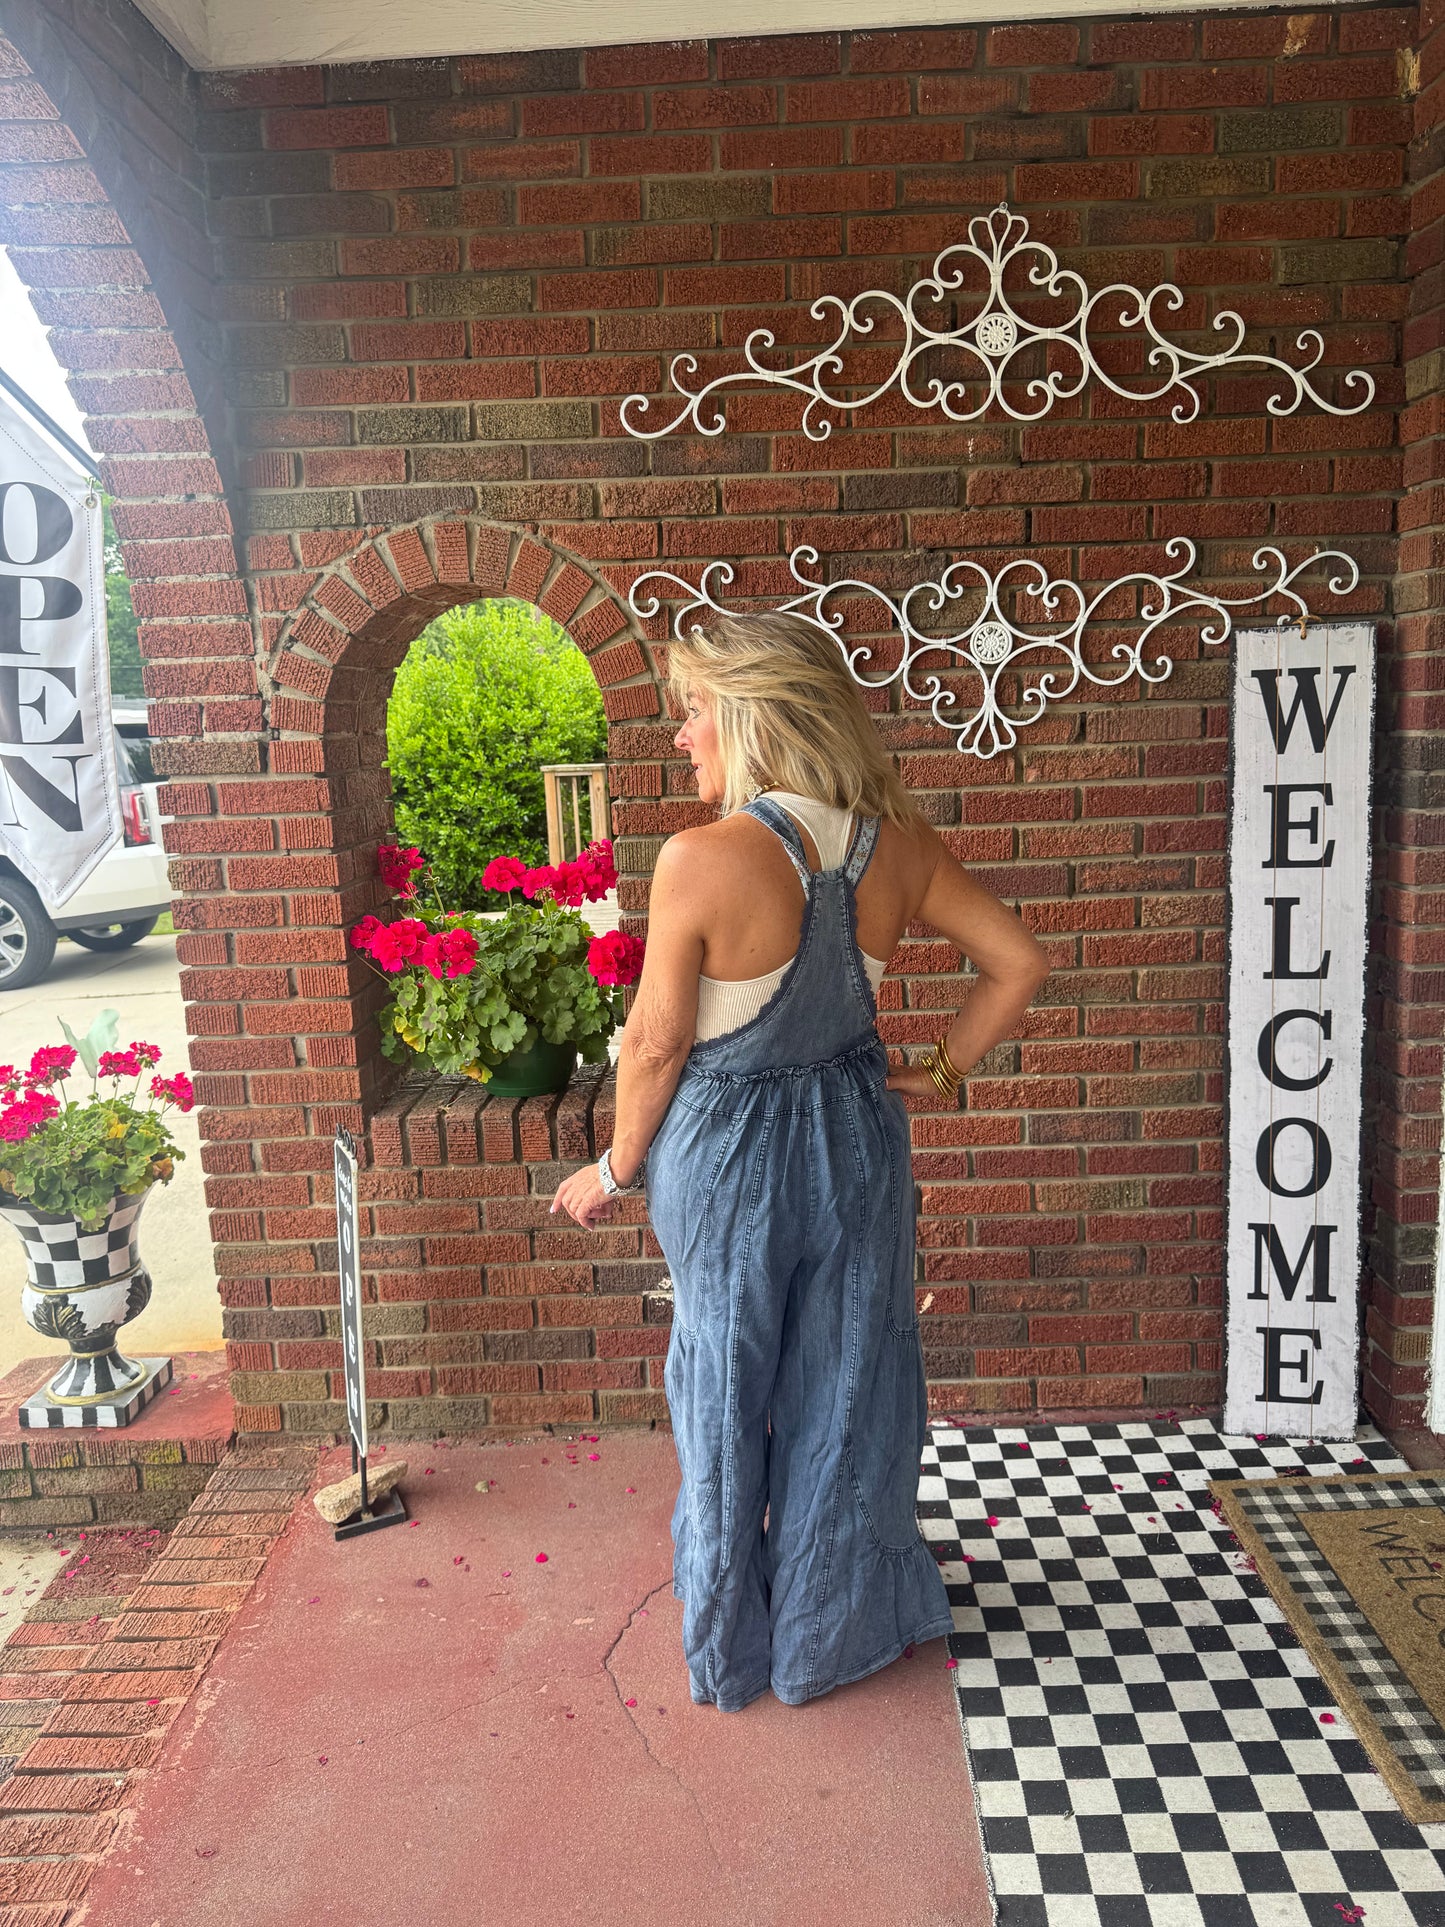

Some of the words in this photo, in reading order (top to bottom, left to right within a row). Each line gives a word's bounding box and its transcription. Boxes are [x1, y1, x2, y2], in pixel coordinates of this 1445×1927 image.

[0, 481, 93, 832] OPEN
[1247, 665, 1357, 1405] WELCOME
[343, 1220, 358, 1418] OPEN
[1359, 1520, 1445, 1648] WELC
